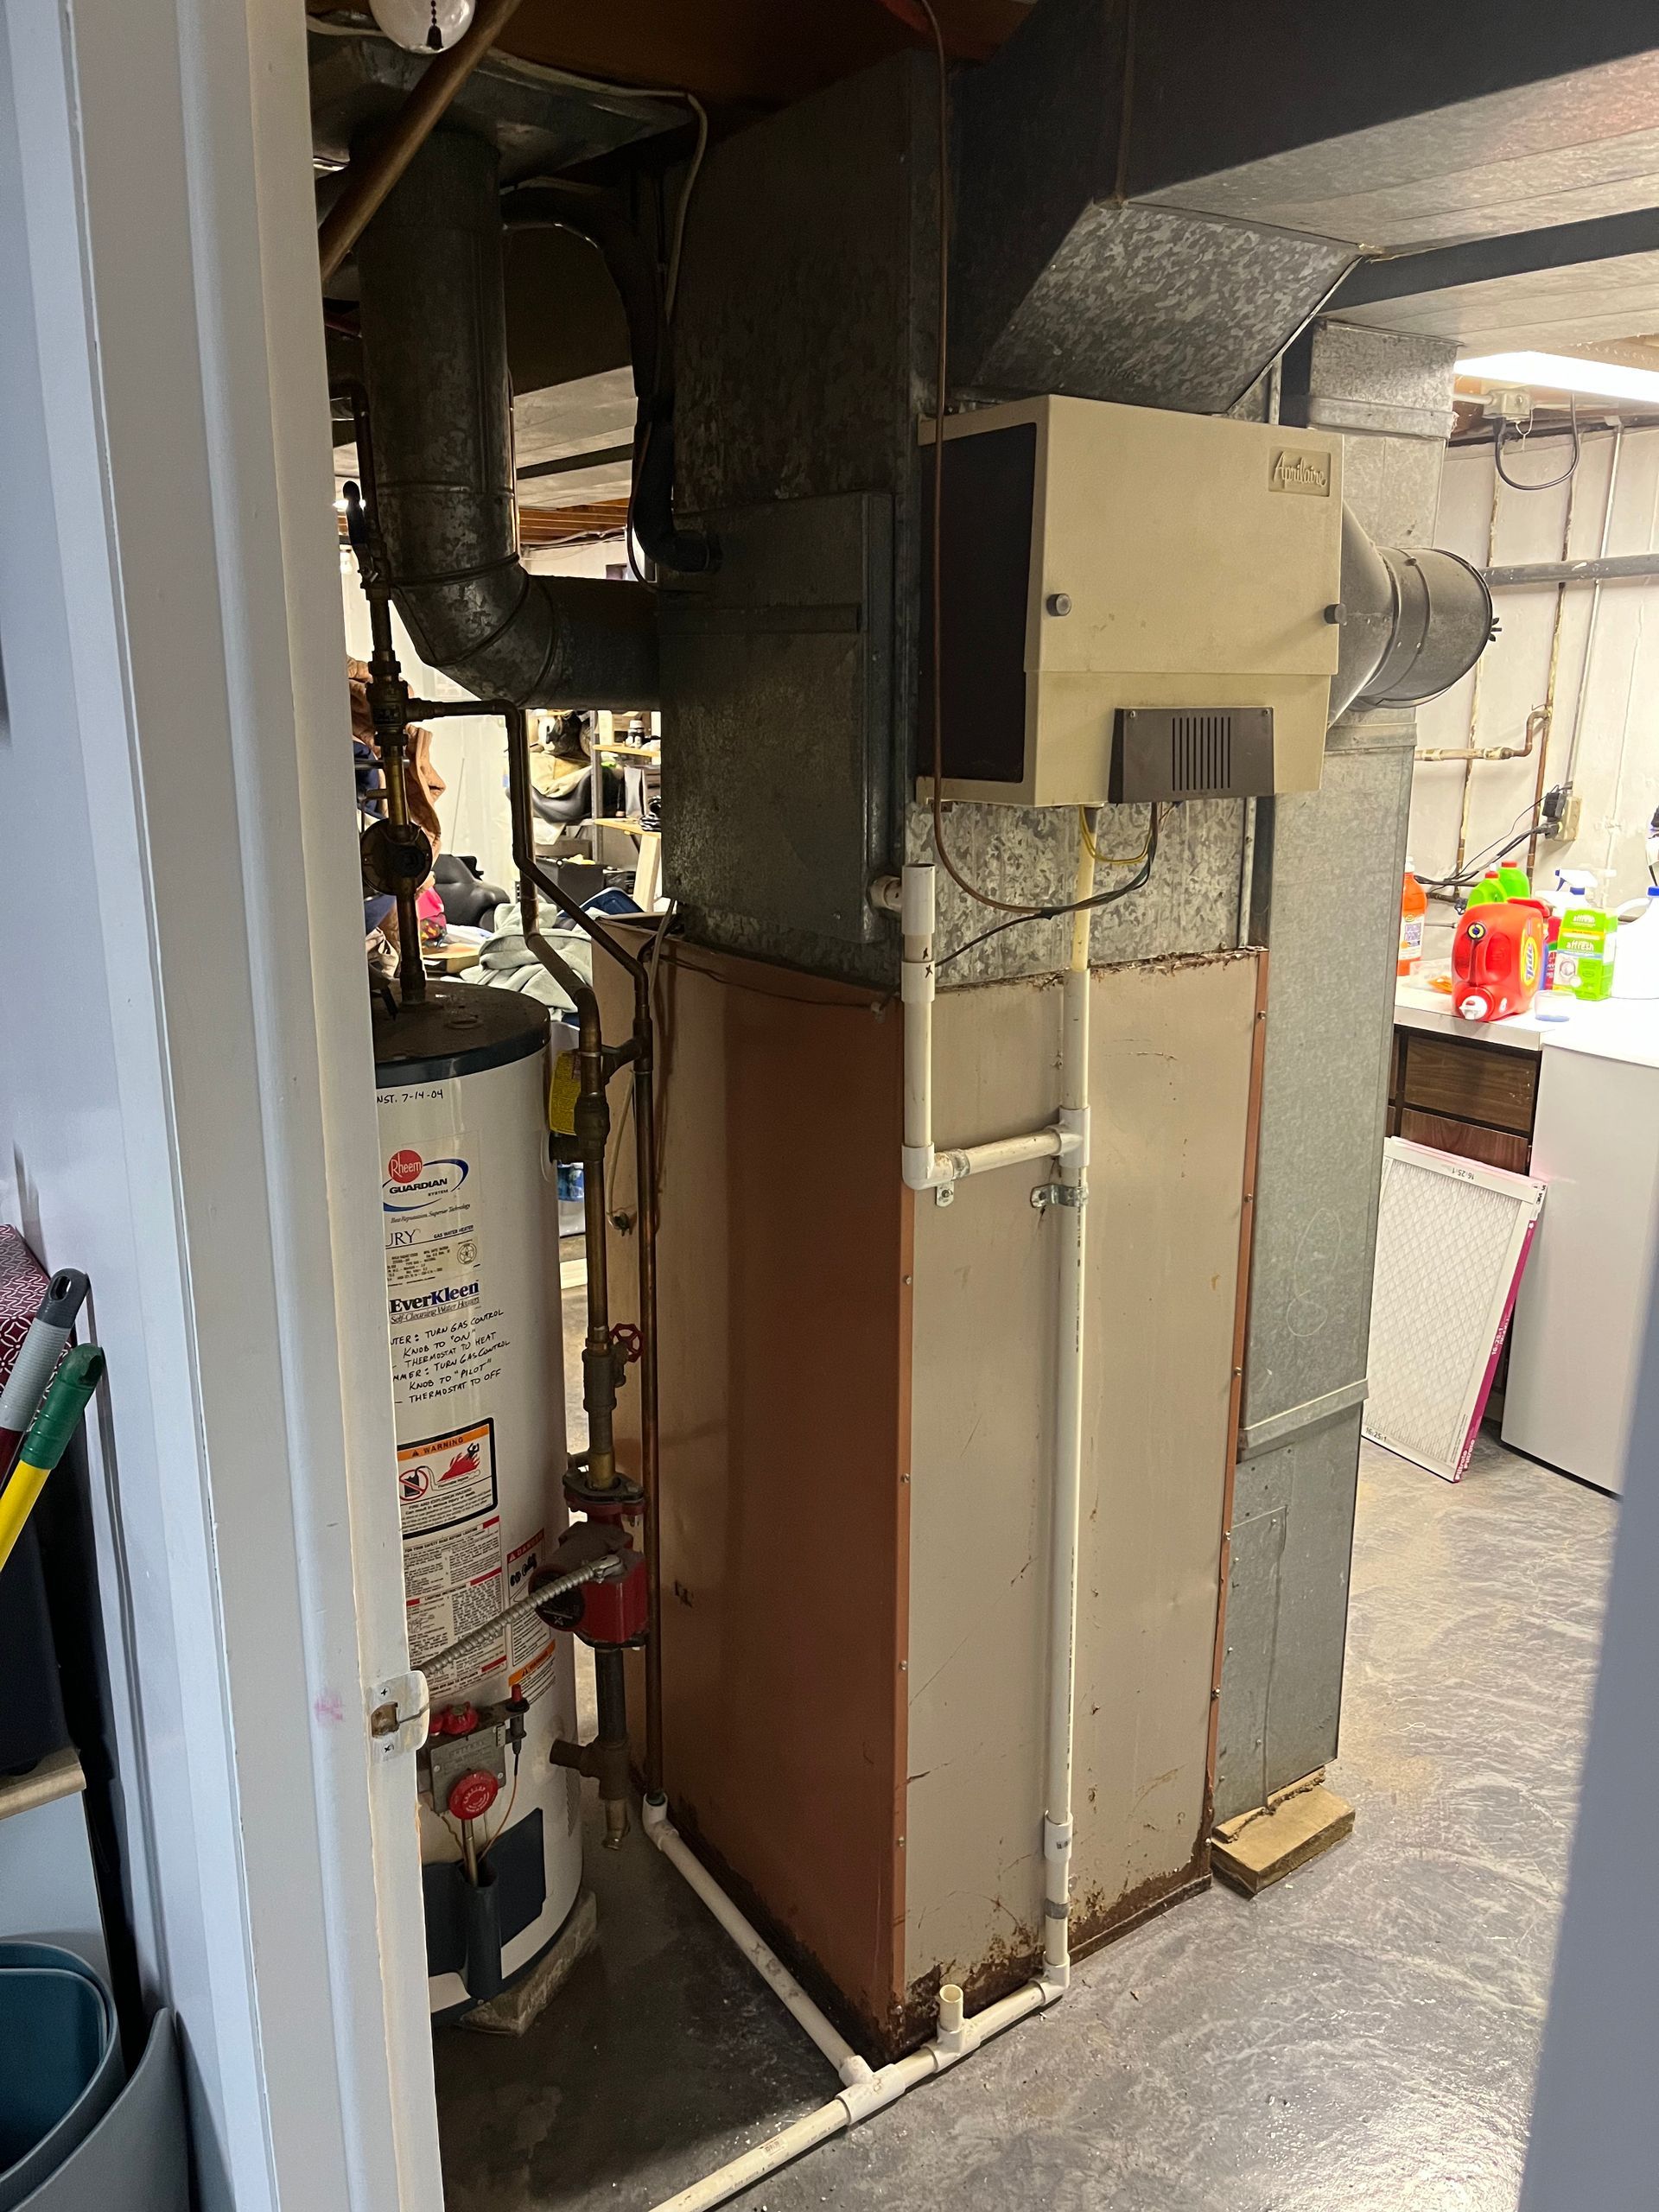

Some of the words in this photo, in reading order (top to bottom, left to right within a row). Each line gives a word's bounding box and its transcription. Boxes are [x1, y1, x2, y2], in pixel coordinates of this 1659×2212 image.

[1272, 451, 1328, 490] Aprilaire
[1566, 940, 1594, 951] affresh
[402, 1089, 444, 1103] 7-14-04
[391, 1152, 422, 1178] Rheem
[389, 1178, 448, 1194] GUARDIAN
[433, 1230, 443, 1239] GAS
[443, 1228, 458, 1237] WATER
[389, 1281, 480, 1313] EverKleen
[425, 1326, 448, 1338] TURN
[450, 1320, 468, 1332] GAS
[470, 1309, 504, 1325] CONTROL
[403, 1345, 429, 1358] KNOB
[404, 1348, 457, 1368] THERMOSTAT
[461, 1341, 472, 1351] TO
[474, 1332, 497, 1346] HEAT
[434, 1359, 457, 1371] TURN
[460, 1353, 478, 1365] GAS
[477, 1340, 511, 1358] CONTROL
[408, 1382, 467, 1403] THERMOSTAT
[470, 1378, 481, 1387] TO
[483, 1368, 502, 1382] OFF
[409, 1379, 435, 1391] KNOB
[439, 1376, 452, 1384] TO
[423, 1436, 464, 1454] WARNING
